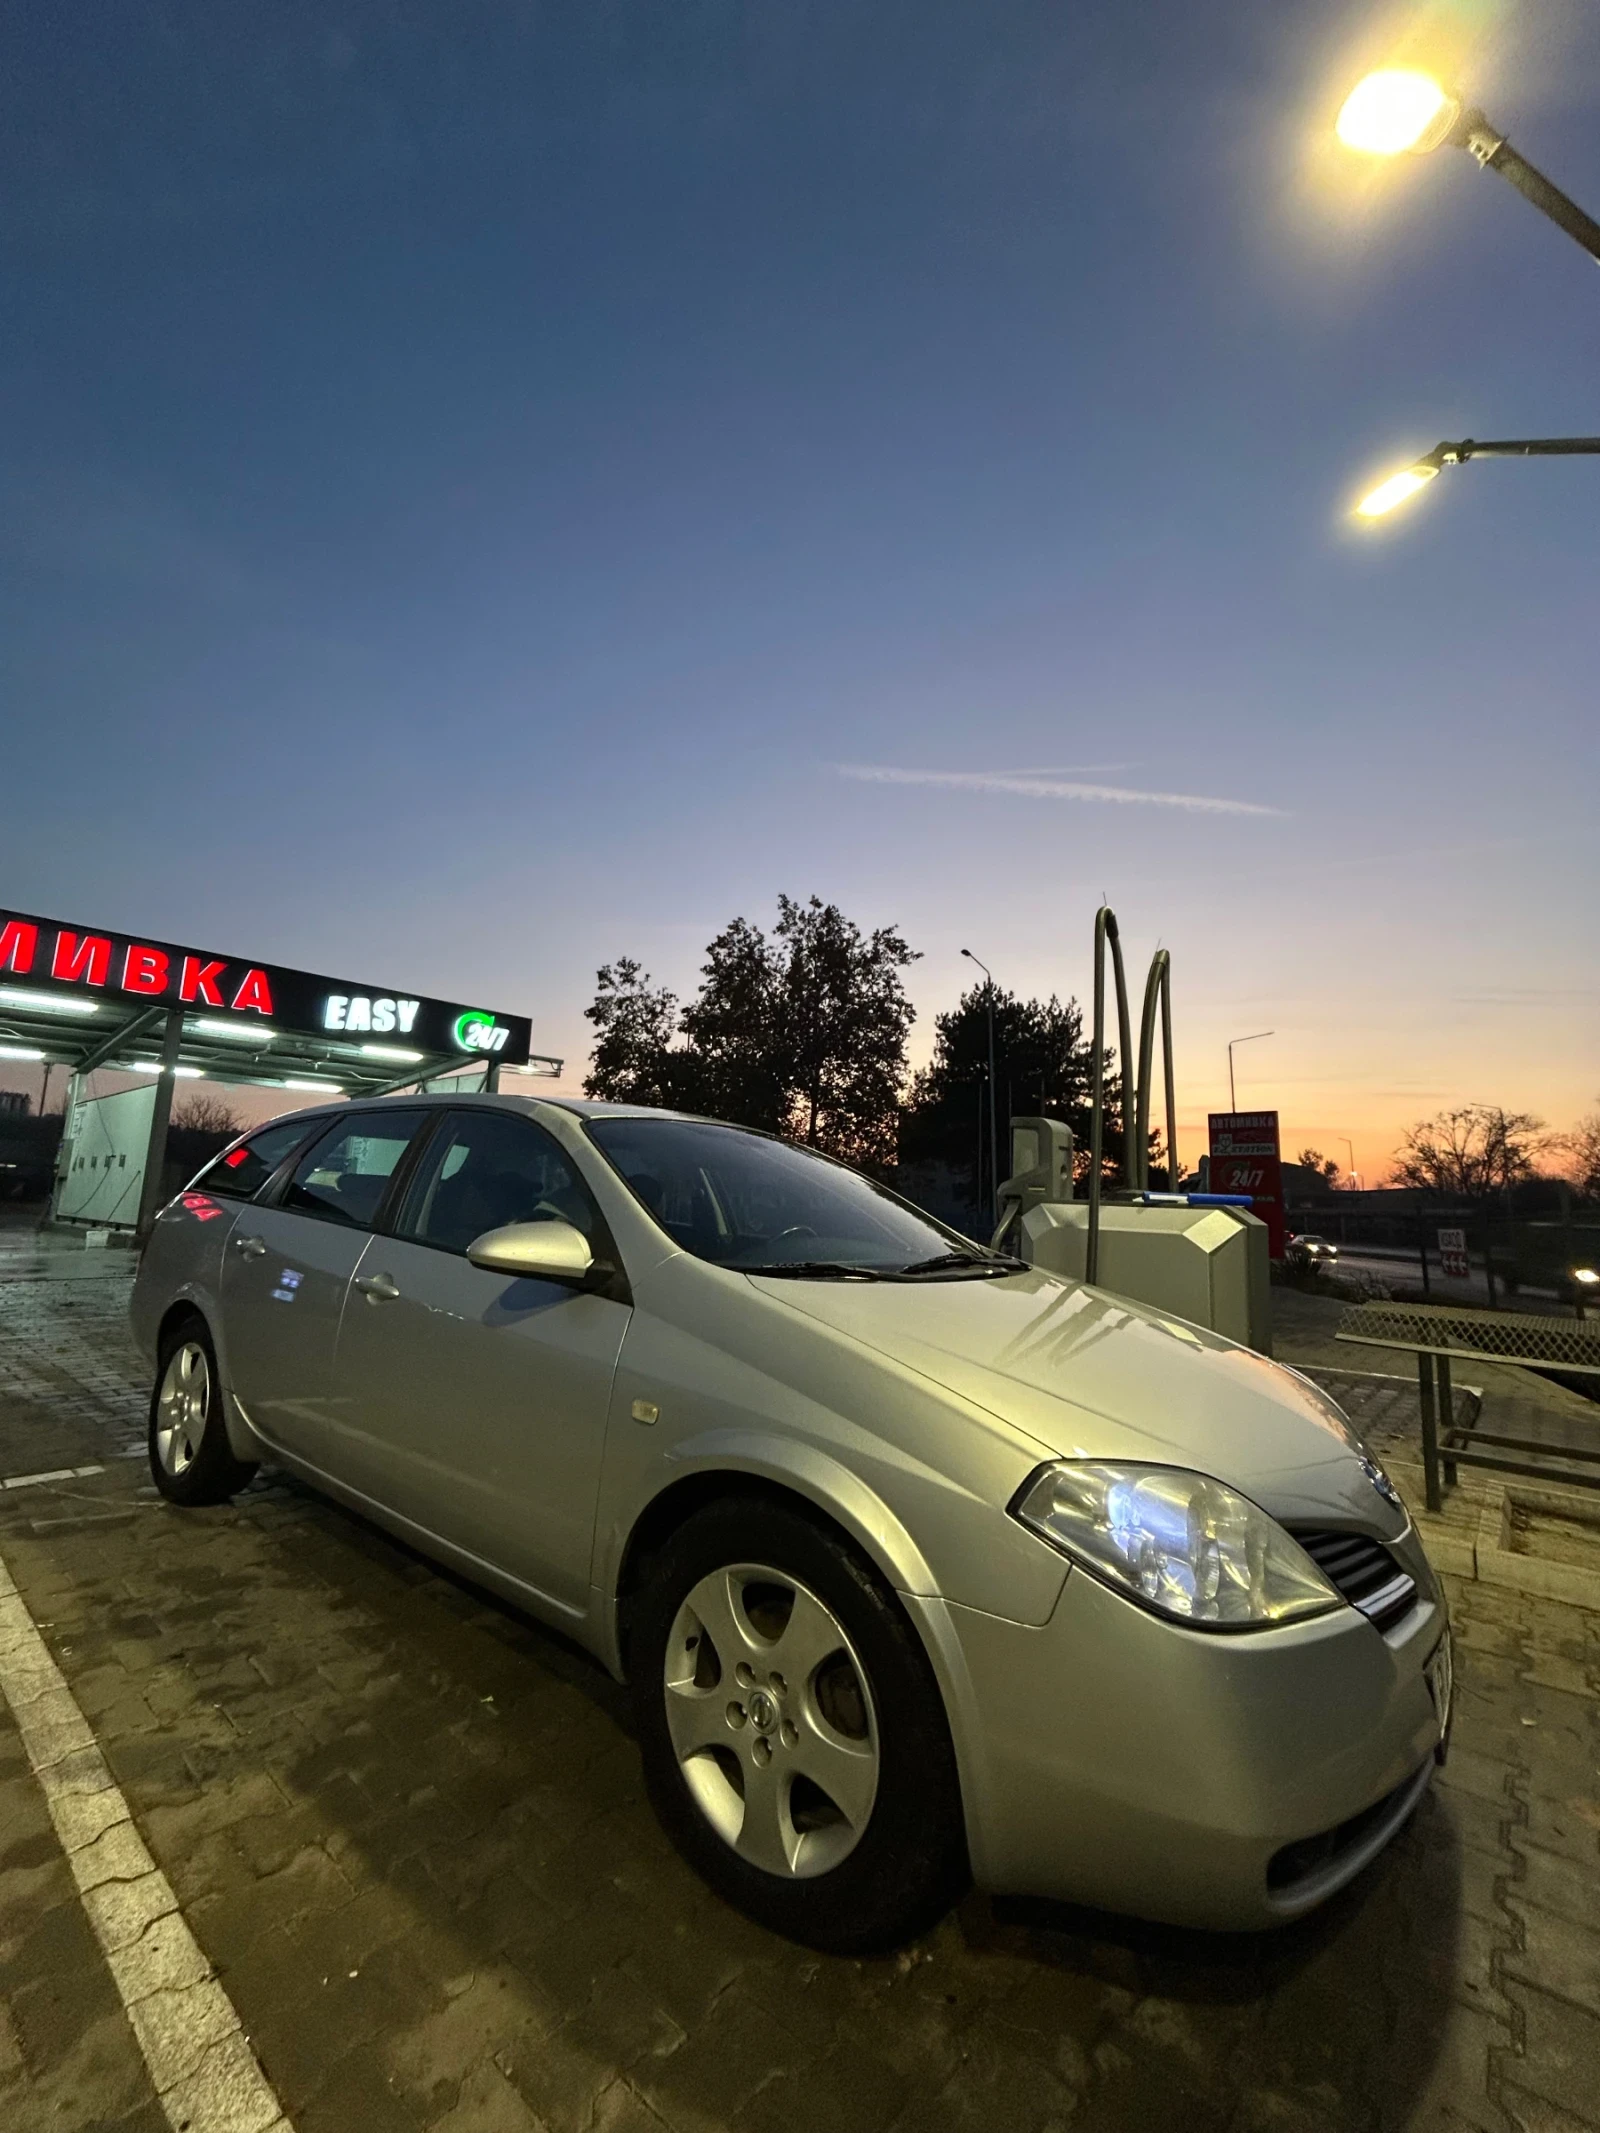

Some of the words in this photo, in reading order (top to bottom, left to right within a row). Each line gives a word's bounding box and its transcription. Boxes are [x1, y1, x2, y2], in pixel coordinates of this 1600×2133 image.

[324, 995, 420, 1033] EASY
[462, 1020, 510, 1051] 24/7
[1211, 1115, 1275, 1129] АВТОМИВКА
[1230, 1169, 1265, 1187] 24/7
